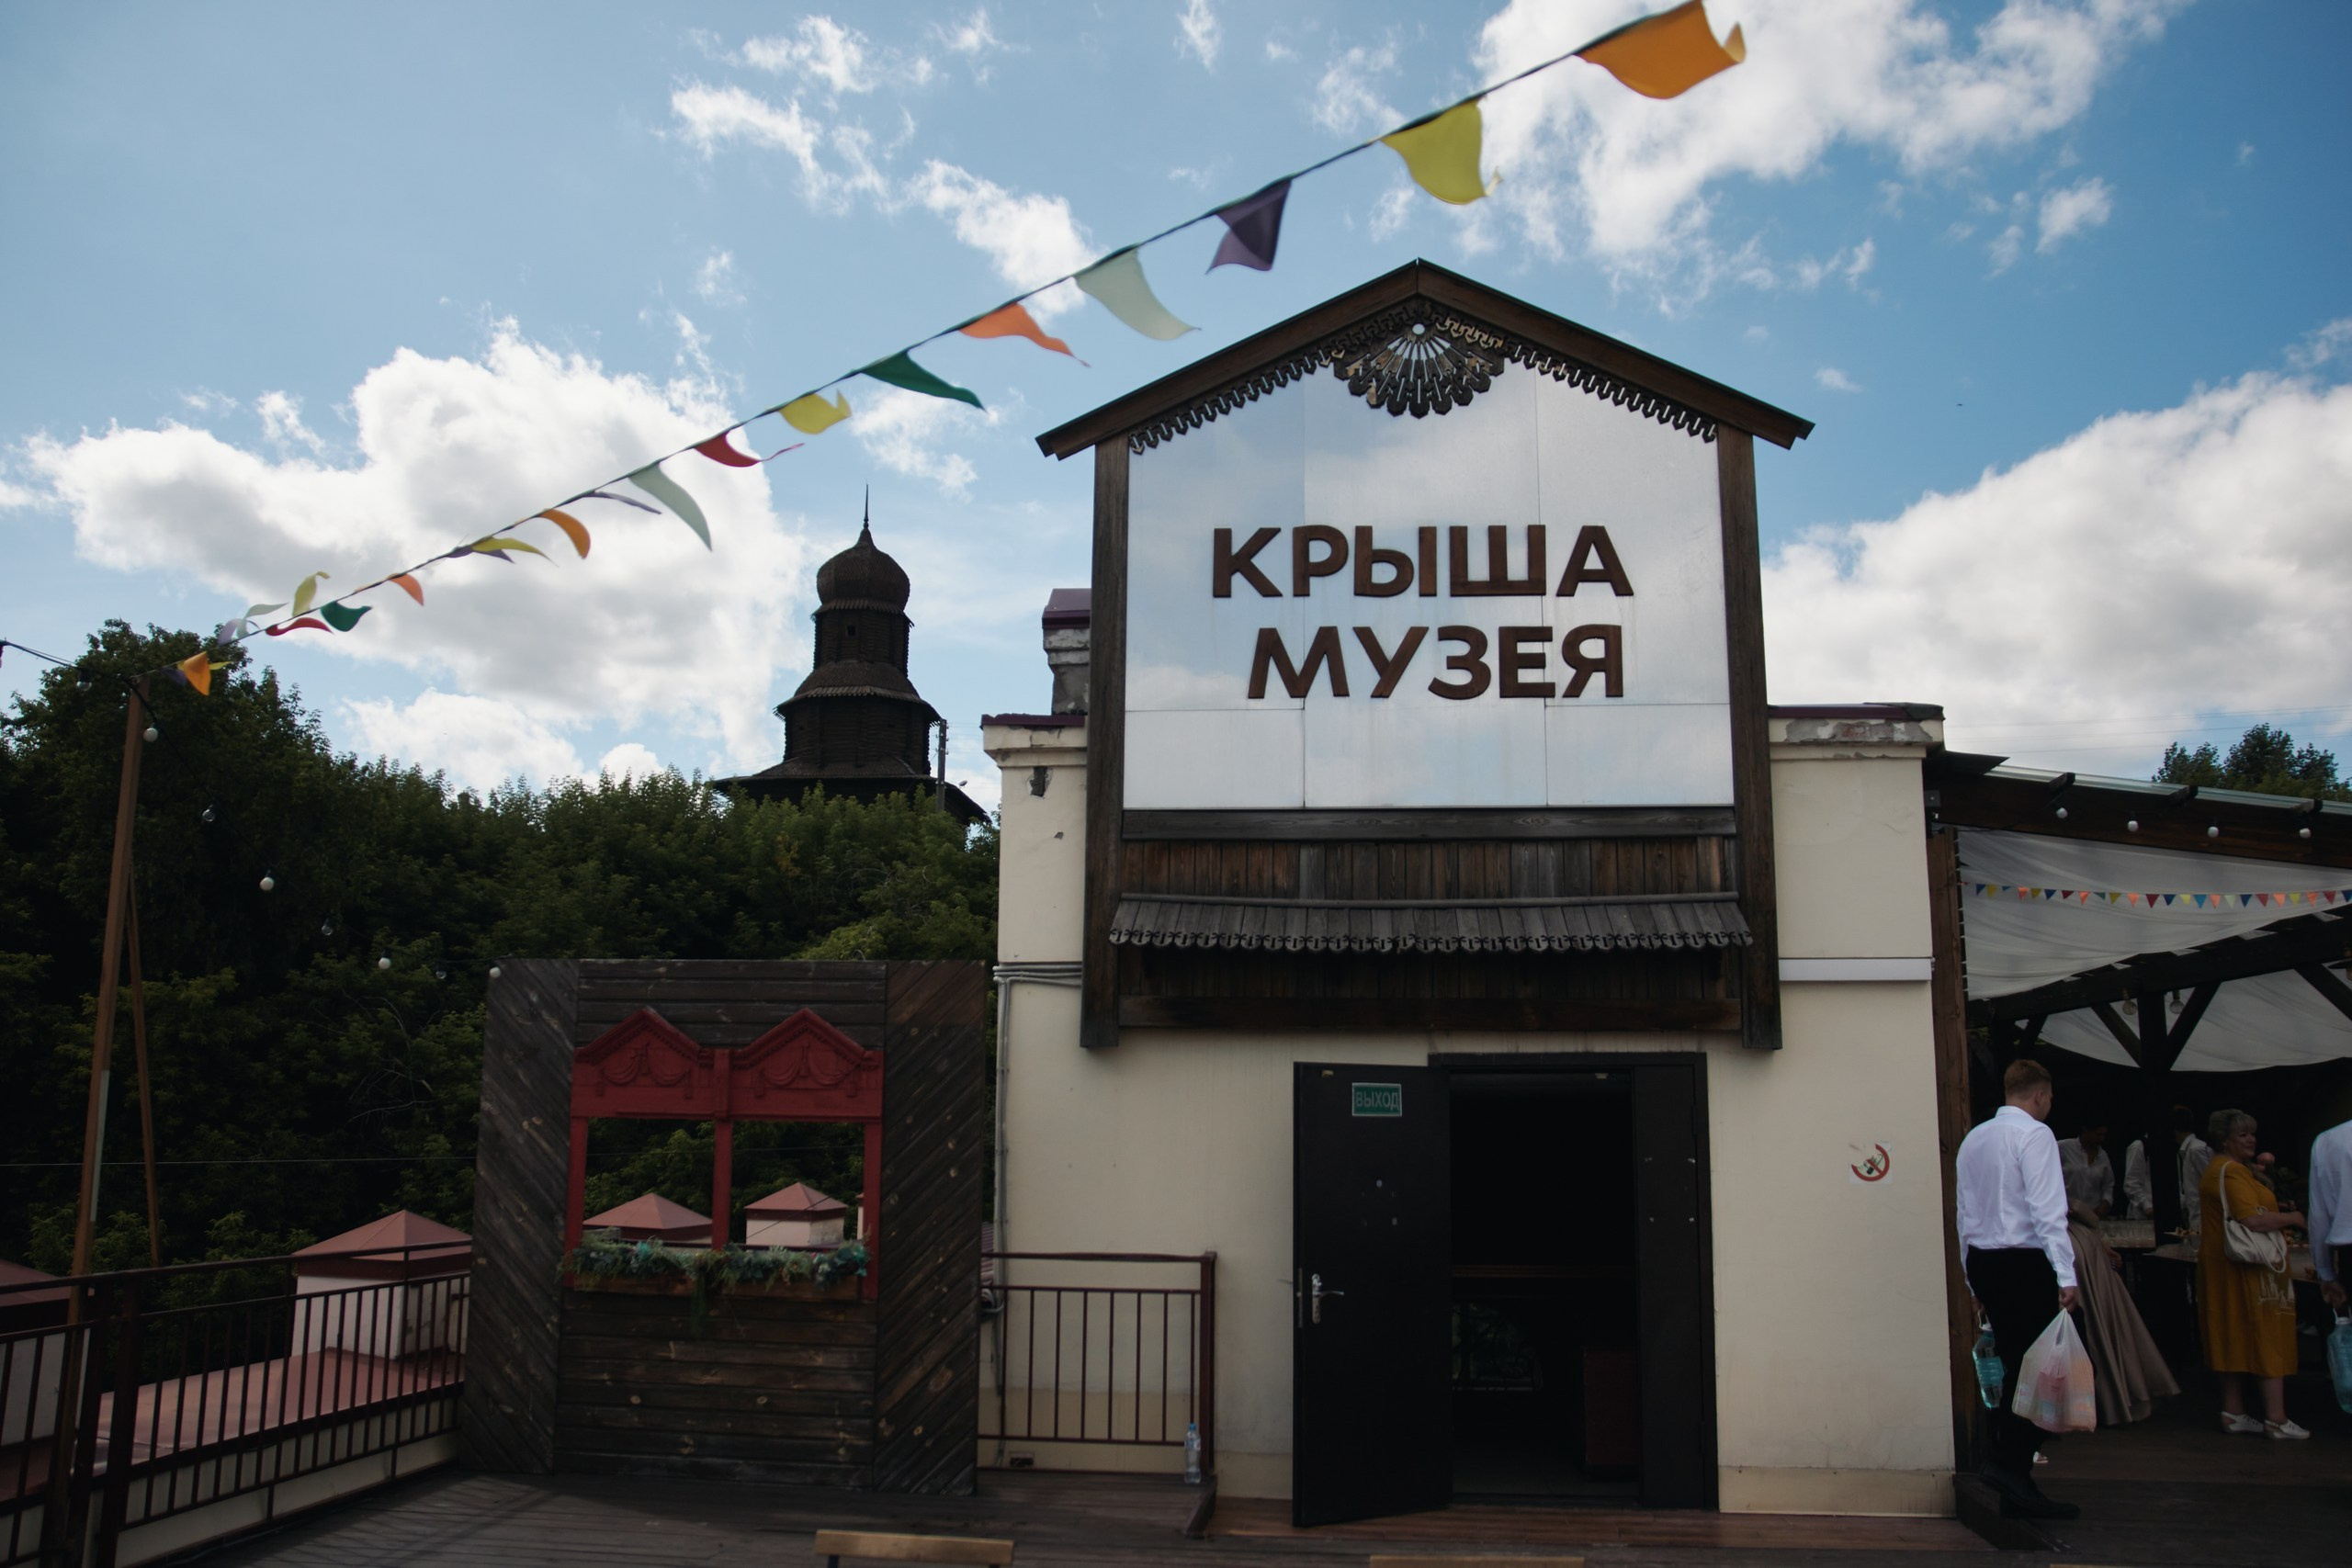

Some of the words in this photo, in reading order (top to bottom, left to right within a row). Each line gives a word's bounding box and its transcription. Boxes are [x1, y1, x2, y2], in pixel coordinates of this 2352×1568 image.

[1213, 525, 1634, 598] КРЫША
[1248, 625, 1623, 700] МУЗЕЯ
[1356, 1091, 1399, 1111] ВЫХОД
